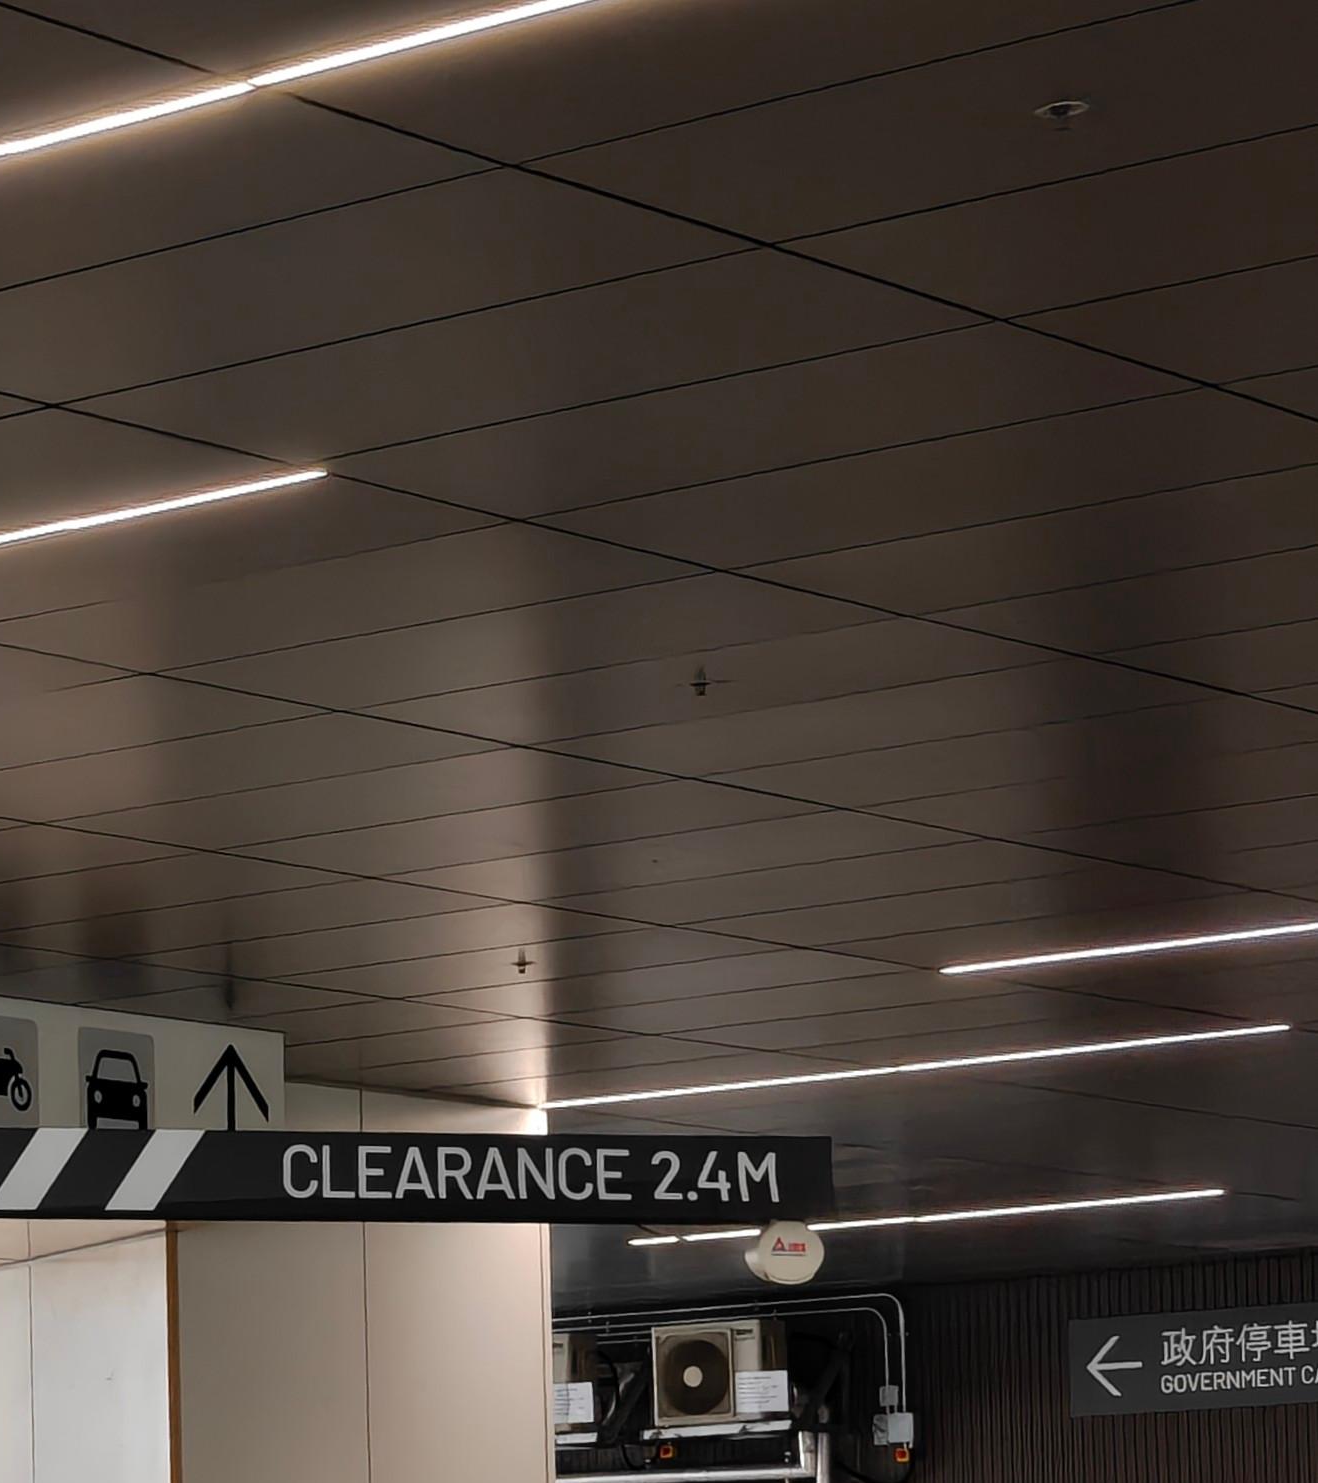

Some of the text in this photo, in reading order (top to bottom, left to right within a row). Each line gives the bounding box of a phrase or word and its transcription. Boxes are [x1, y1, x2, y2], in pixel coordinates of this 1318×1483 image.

[282, 1143, 780, 1203] CLEARANCE 2.4M
[1161, 1364, 1318, 1394] GOVERNMENT C
